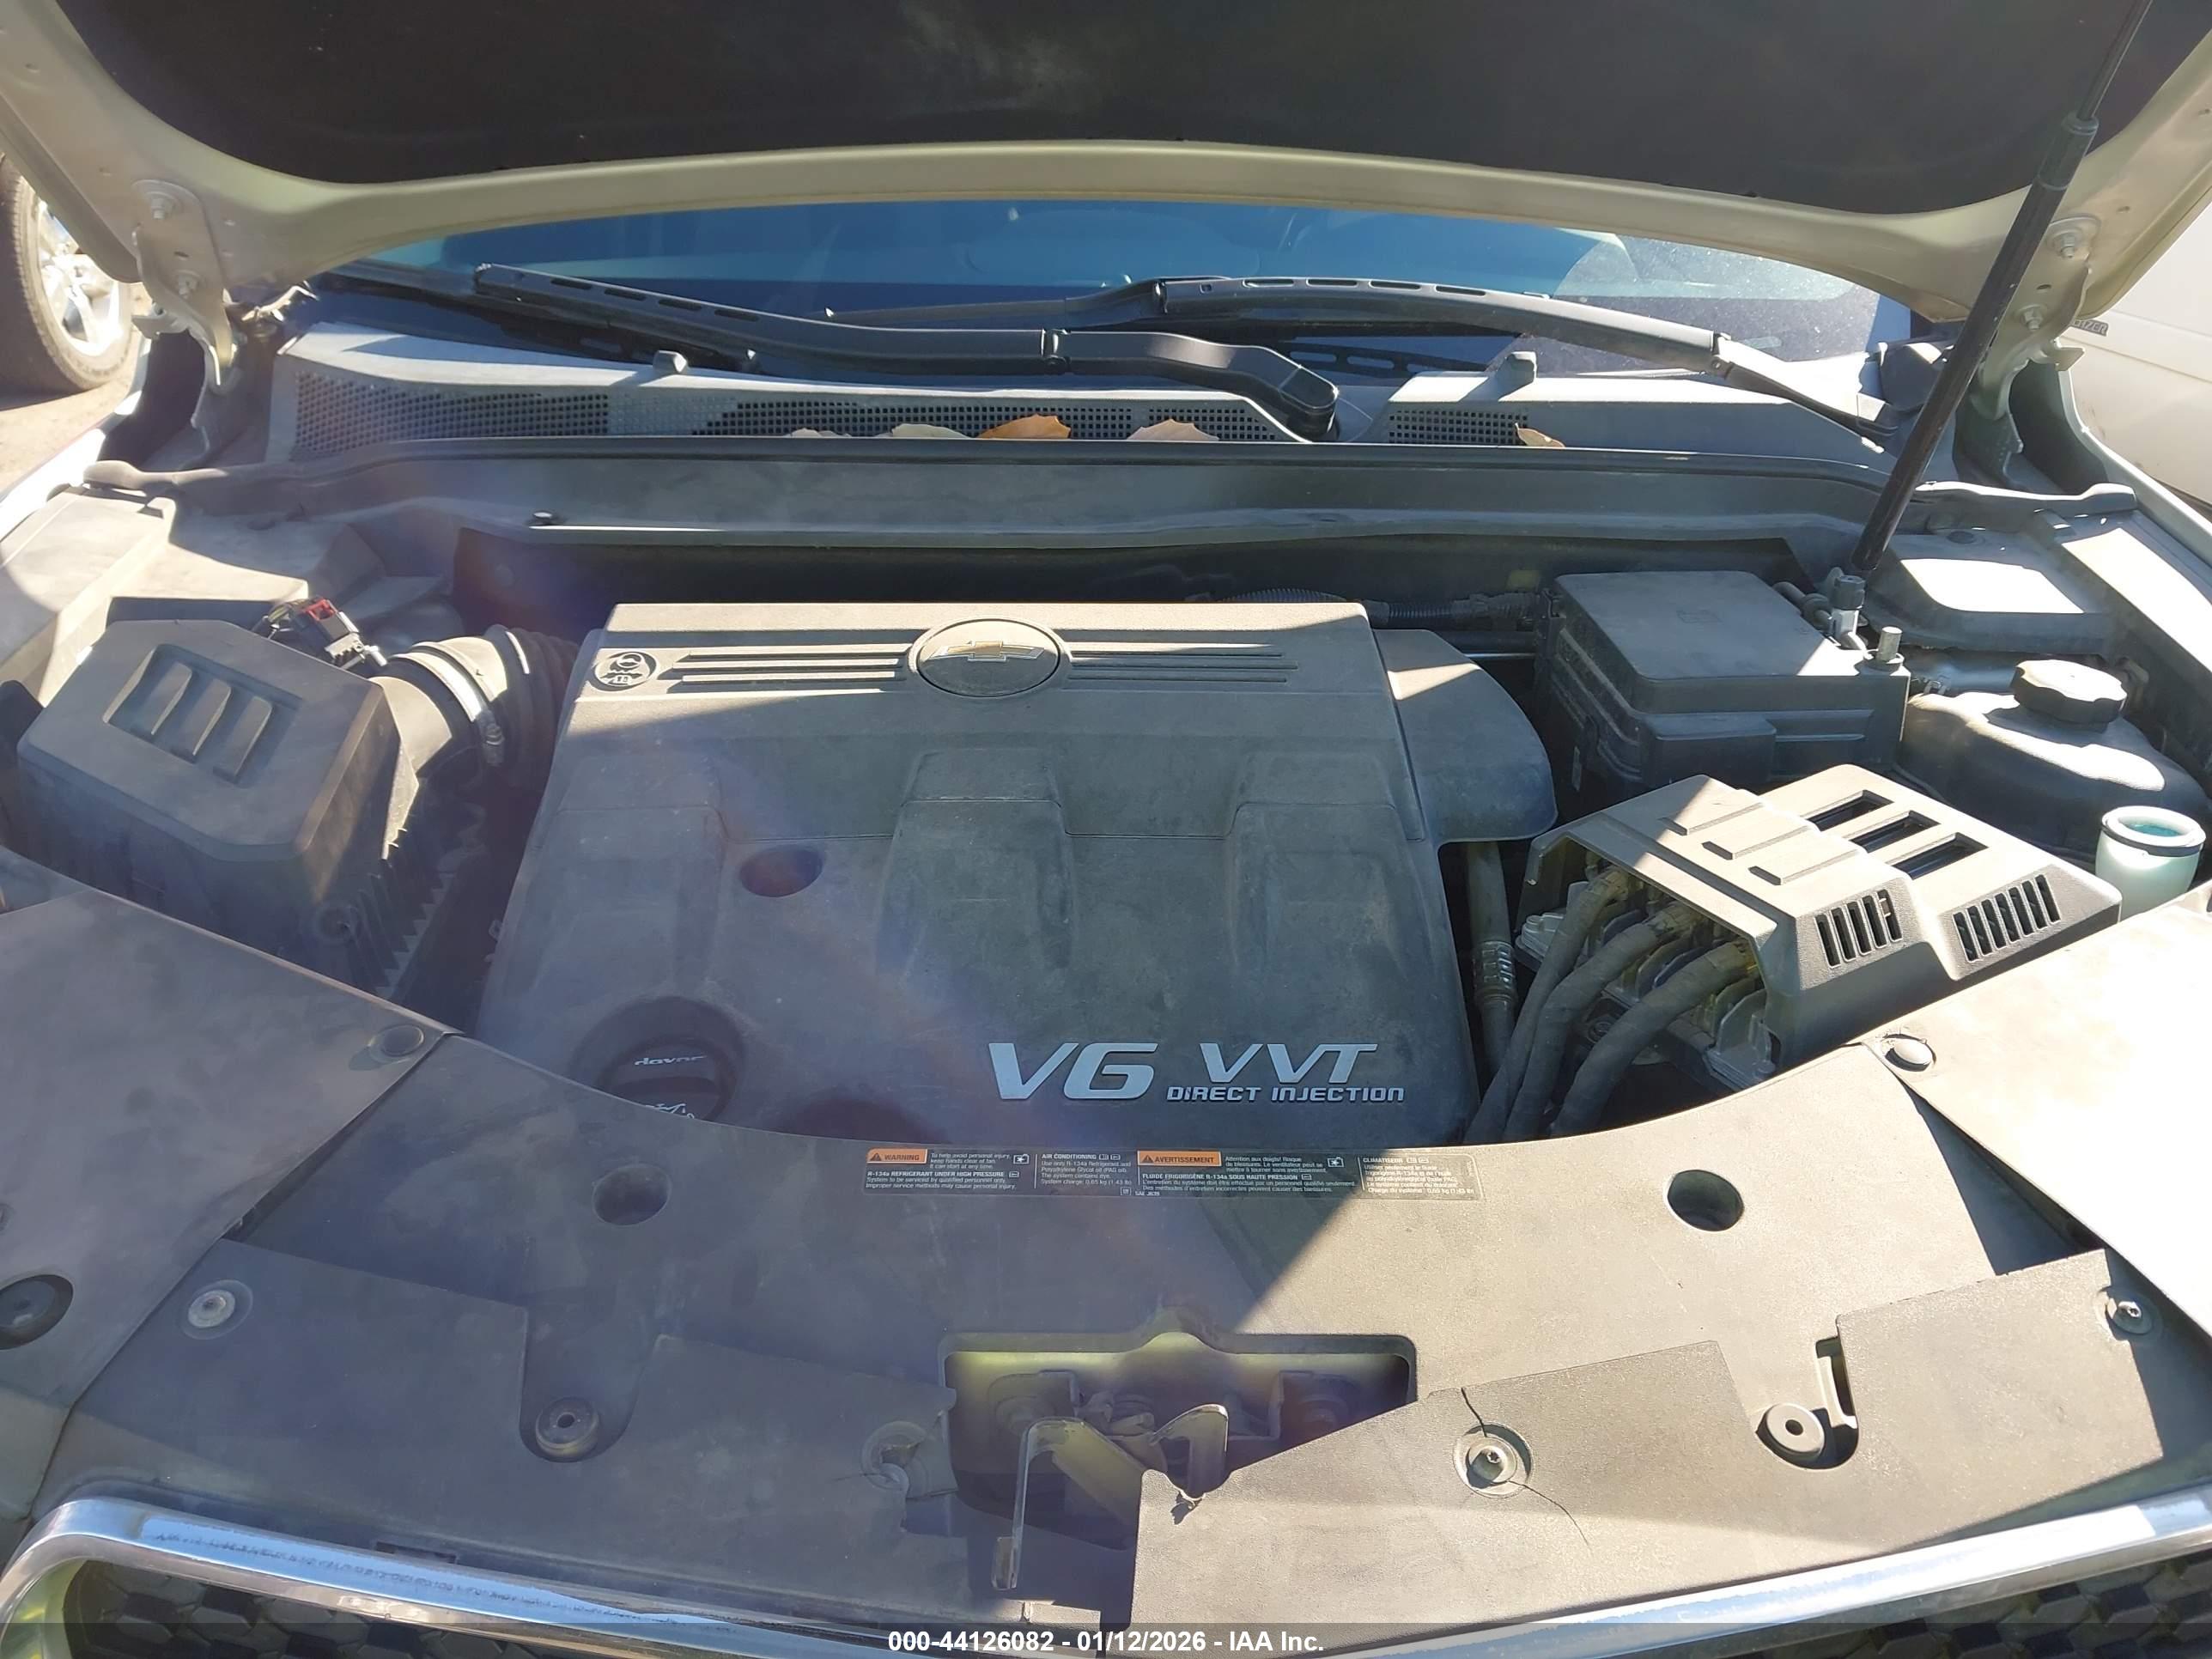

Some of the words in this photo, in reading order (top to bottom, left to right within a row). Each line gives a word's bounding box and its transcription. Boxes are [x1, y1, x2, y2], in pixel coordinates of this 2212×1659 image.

[988, 1042, 1158, 1100] V6
[1200, 1042, 1378, 1084] VVT
[1166, 1086, 1261, 1102] DIRECT
[1271, 1086, 1405, 1102] INJECTION
